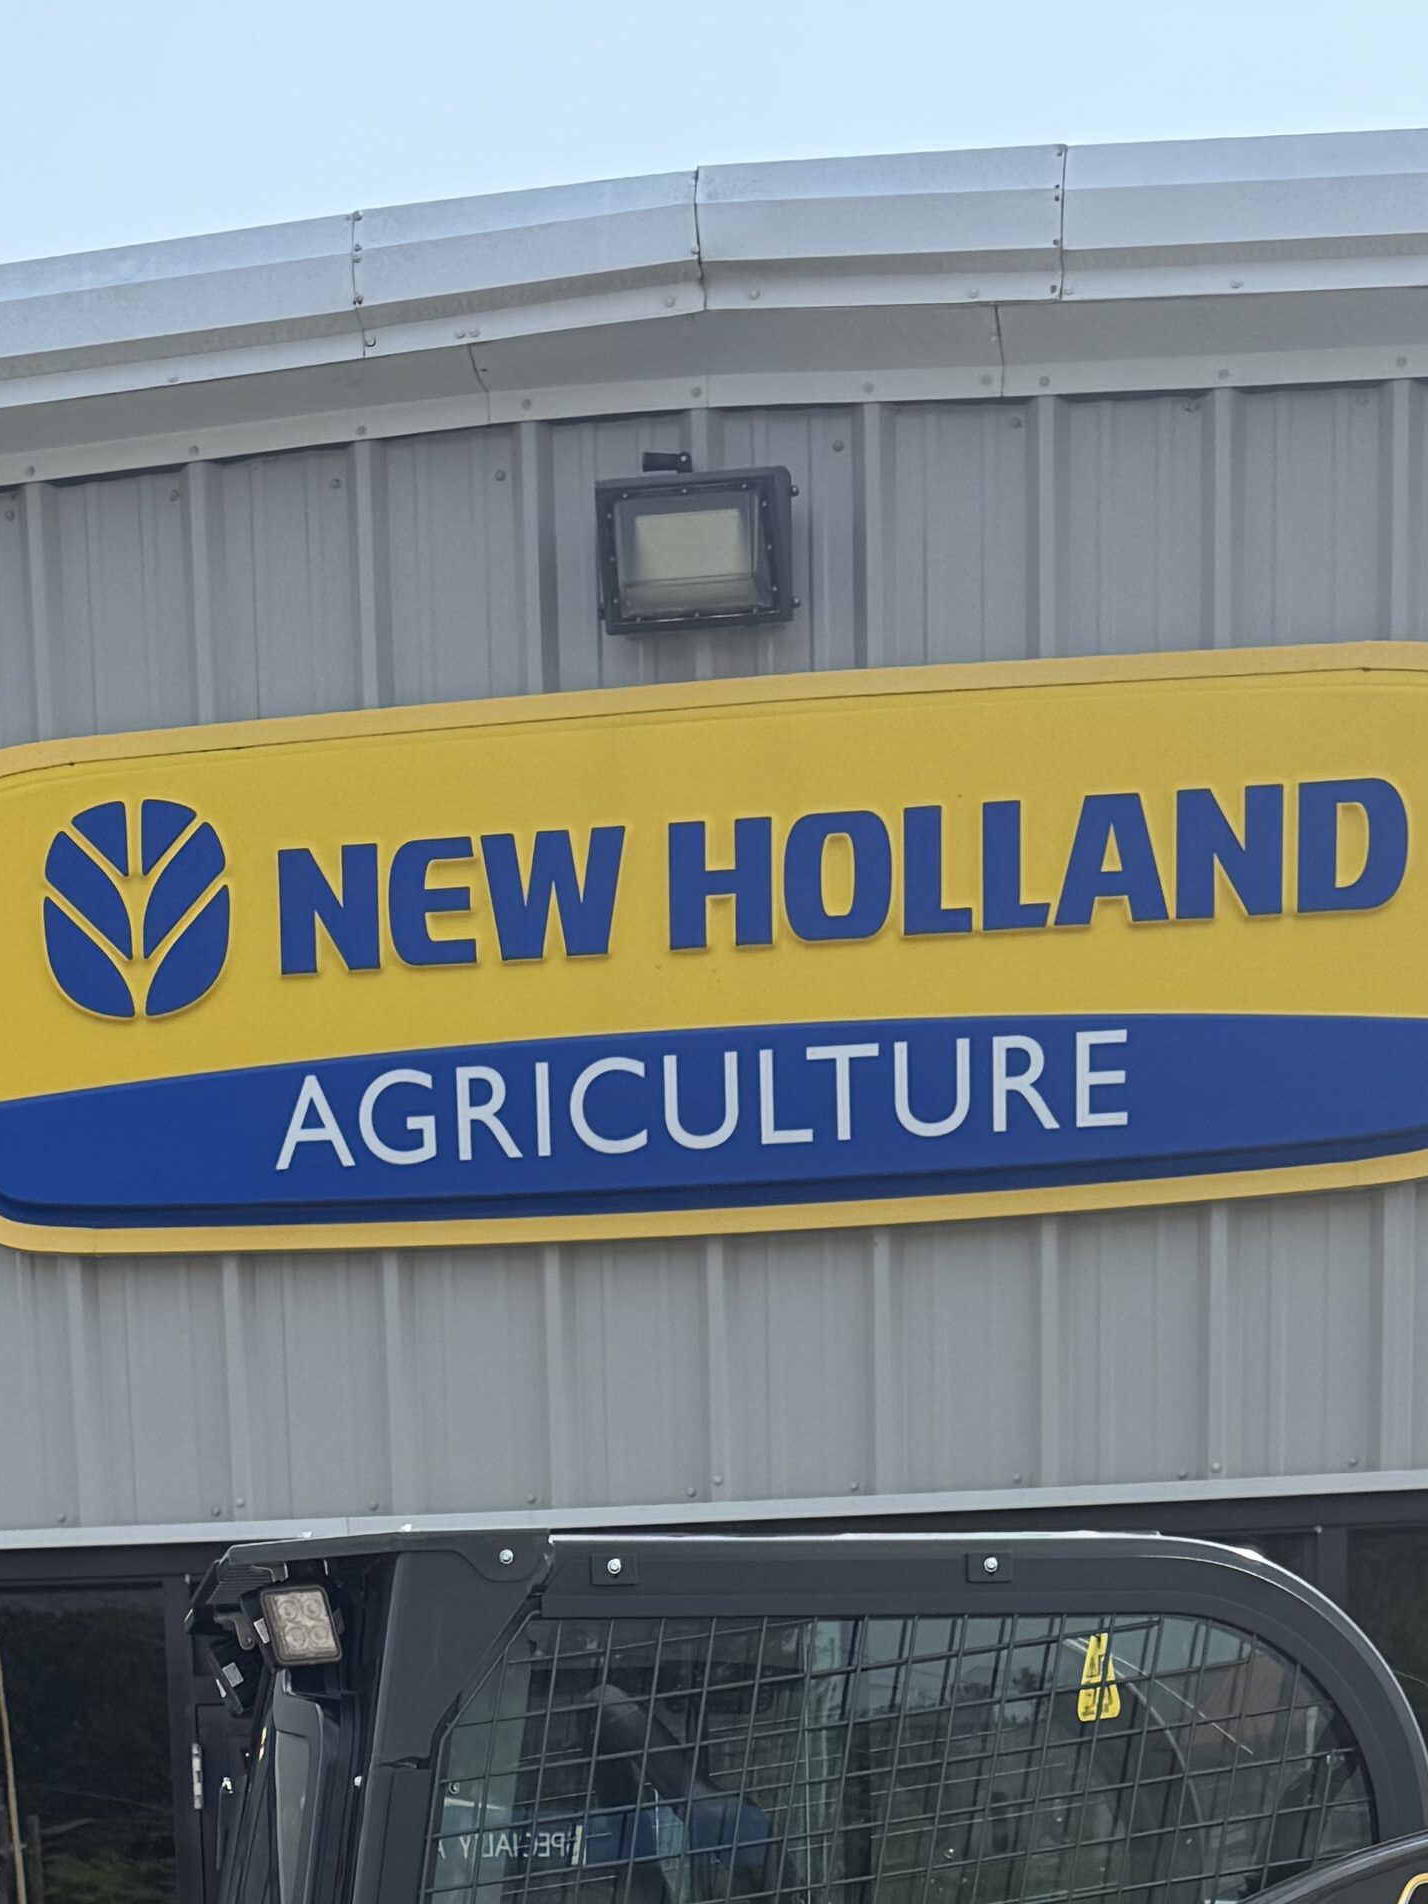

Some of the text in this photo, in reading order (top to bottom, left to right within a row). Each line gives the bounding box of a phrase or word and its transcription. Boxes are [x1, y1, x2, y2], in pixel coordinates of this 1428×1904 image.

[278, 776, 1409, 977] NEW HOLLAND
[275, 1029, 1129, 1170] AGRICULTURE
